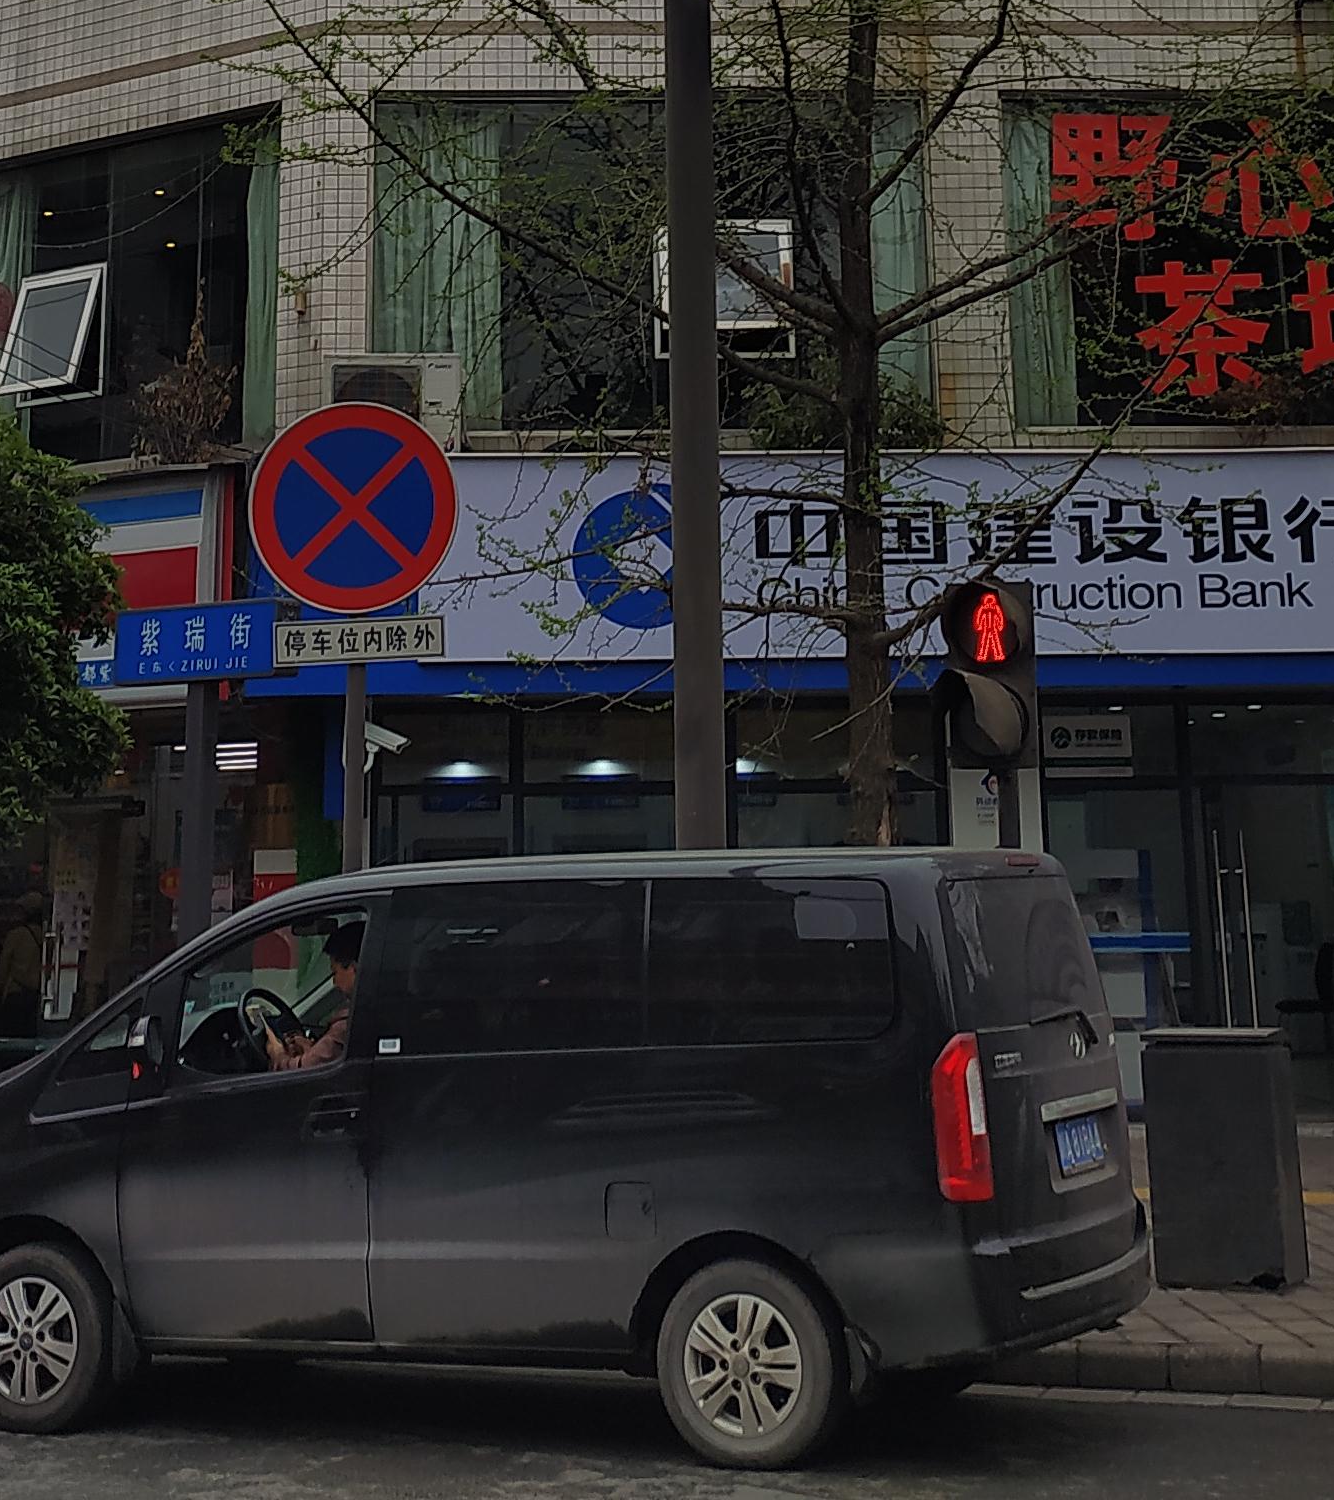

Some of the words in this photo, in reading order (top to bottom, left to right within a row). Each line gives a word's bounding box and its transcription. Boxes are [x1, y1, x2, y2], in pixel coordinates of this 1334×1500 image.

[1199, 573, 1314, 609] Bank
[140, 612, 253, 657] 紫瑞街
[285, 623, 436, 657] 停车位内除外
[180, 658, 218, 673] ZIRUI
[225, 655, 249, 670] JIE
